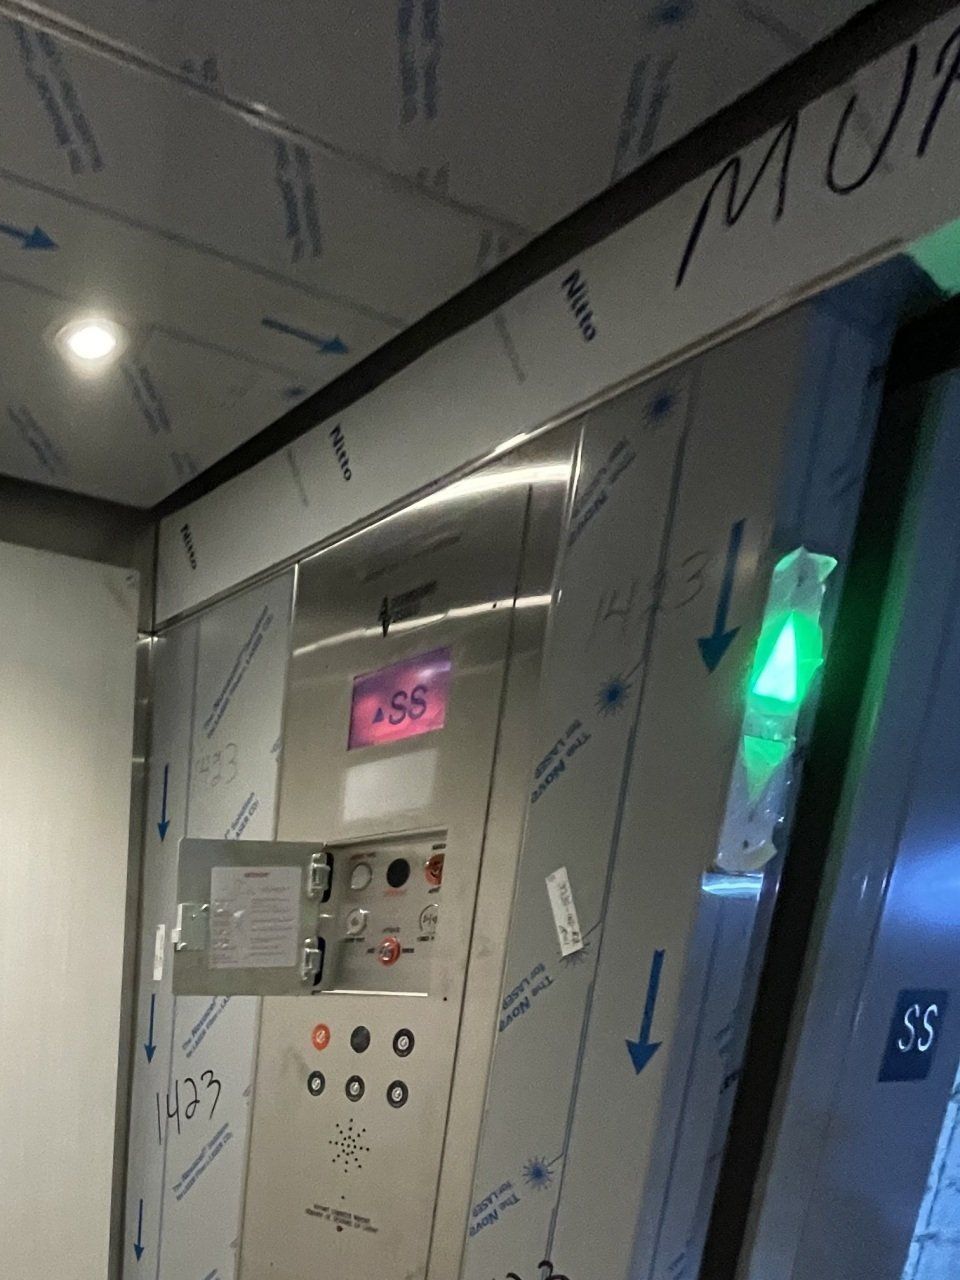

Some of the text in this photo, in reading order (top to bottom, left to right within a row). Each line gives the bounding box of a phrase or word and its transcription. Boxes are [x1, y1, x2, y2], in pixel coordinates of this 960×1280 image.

[561, 268, 597, 343] Nitto
[330, 423, 352, 482] Nitto
[180, 523, 197, 571] Nitto
[388, 684, 428, 726] SS
[530, 963, 545, 979] for
[531, 975, 554, 997] The
[898, 1003, 939, 1053] SS
[156, 1069, 222, 1146] 1423
[499, 1180, 513, 1195] for
[499, 1191, 521, 1211] The
